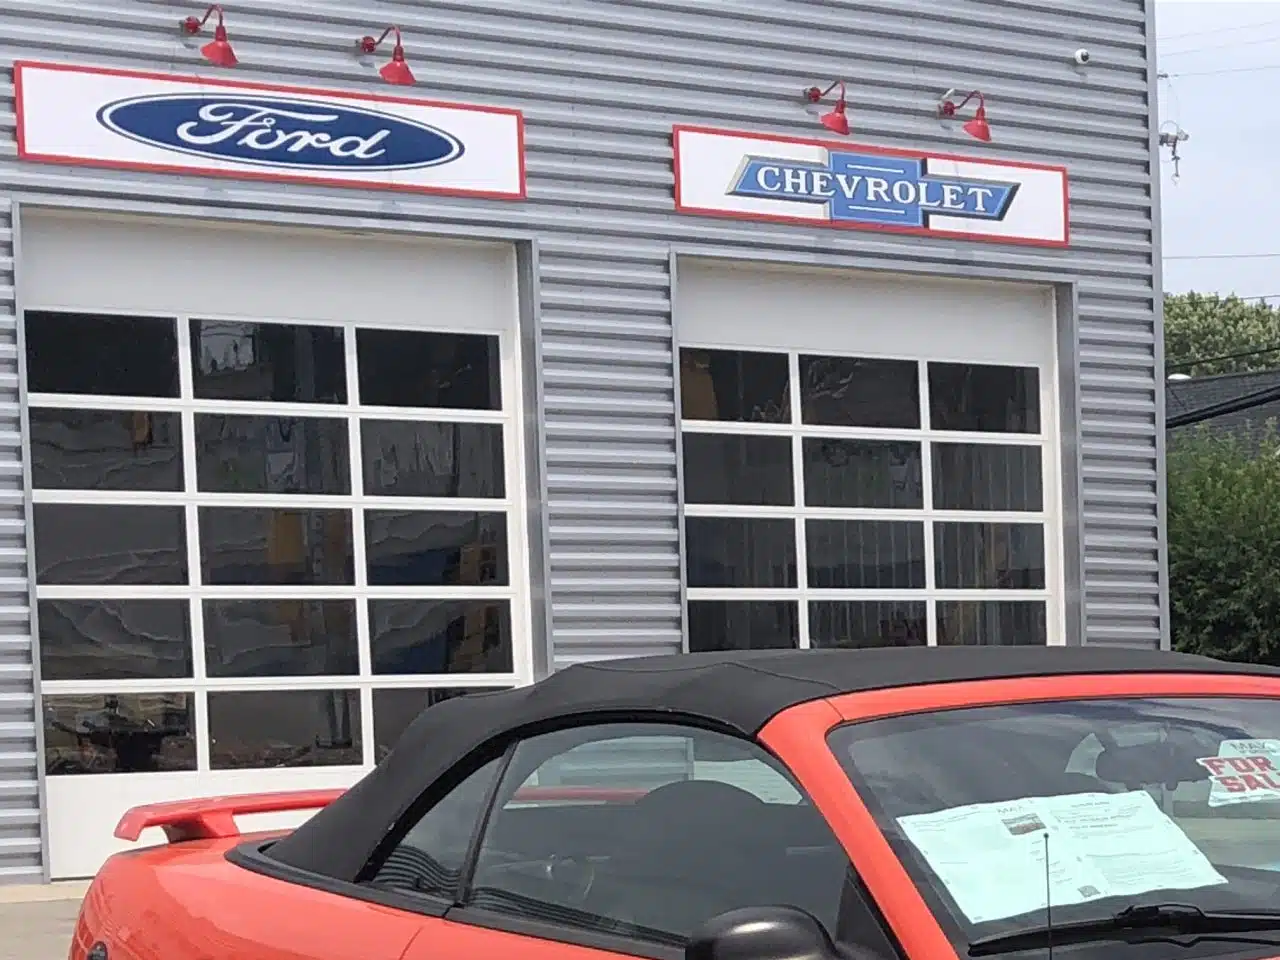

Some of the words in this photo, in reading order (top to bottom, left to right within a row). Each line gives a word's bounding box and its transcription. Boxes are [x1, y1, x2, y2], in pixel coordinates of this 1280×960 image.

[177, 103, 391, 159] Ford
[756, 166, 993, 211] CHEVROLET
[1204, 757, 1278, 775] FOR
